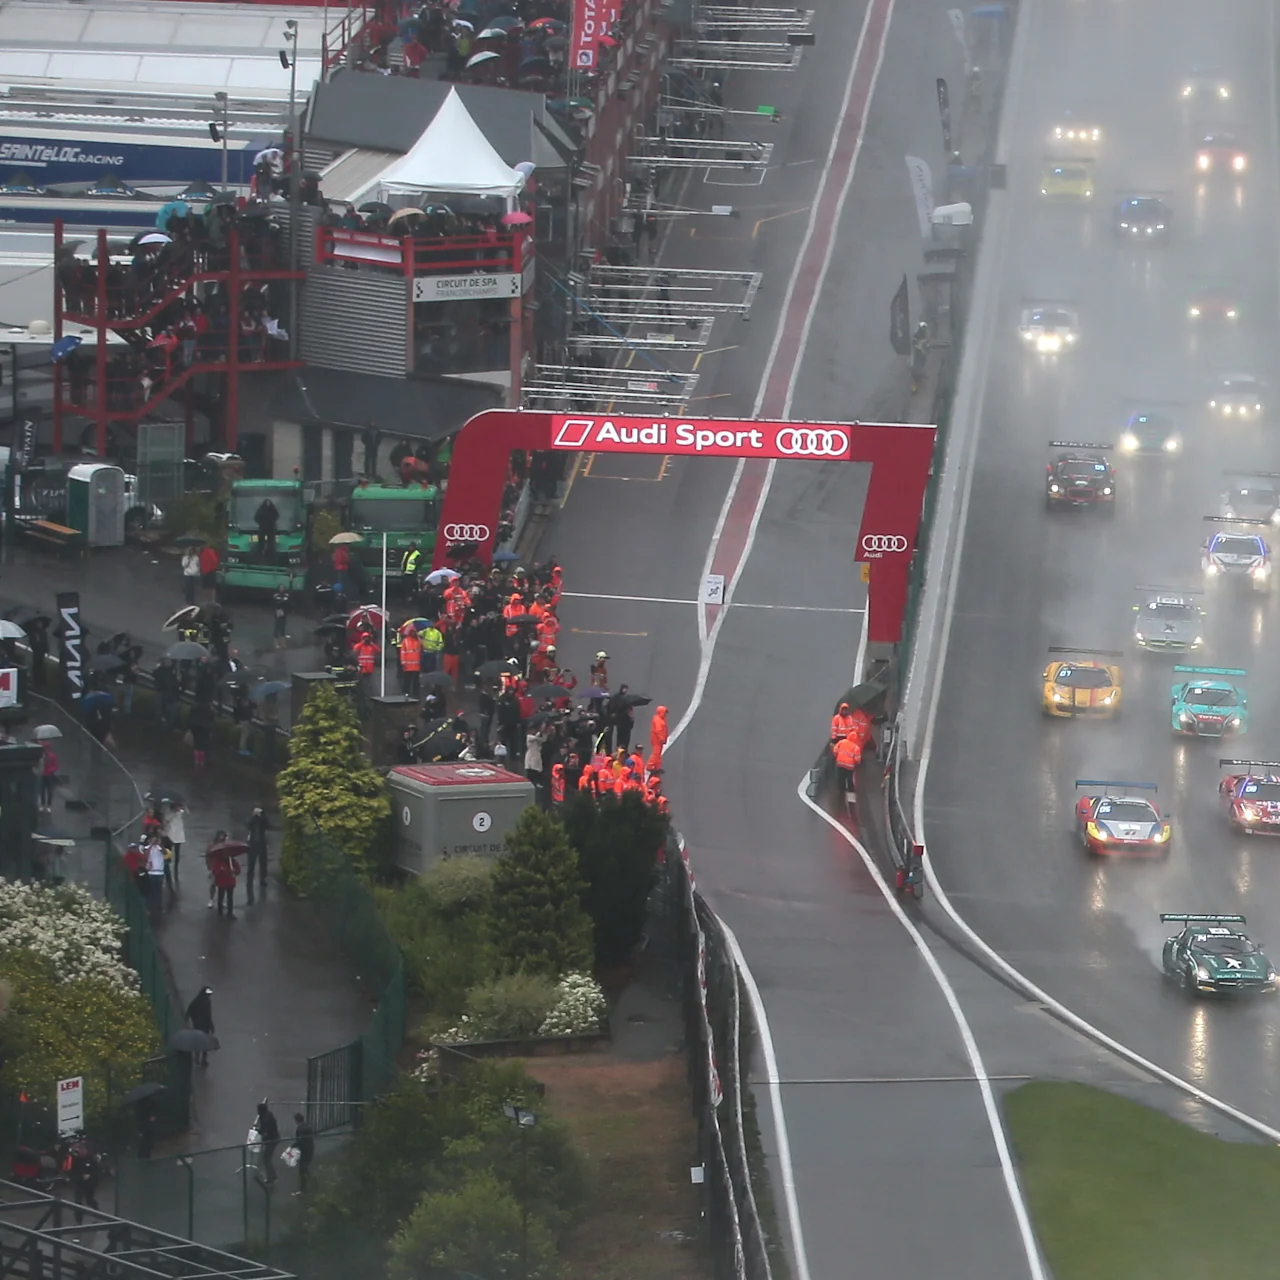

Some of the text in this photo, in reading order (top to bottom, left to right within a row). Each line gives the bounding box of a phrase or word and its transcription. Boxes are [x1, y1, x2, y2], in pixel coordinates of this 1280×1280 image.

[78, 154, 124, 165] RACING
[436, 277, 498, 289] CIRCUIT DE SPA
[595, 421, 764, 451] Audi Sport
[863, 551, 883, 559] Audi
[479, 817, 485, 827] 2
[454, 844, 488, 853] CIRCUIT
[61, 1080, 80, 1092] LEM
